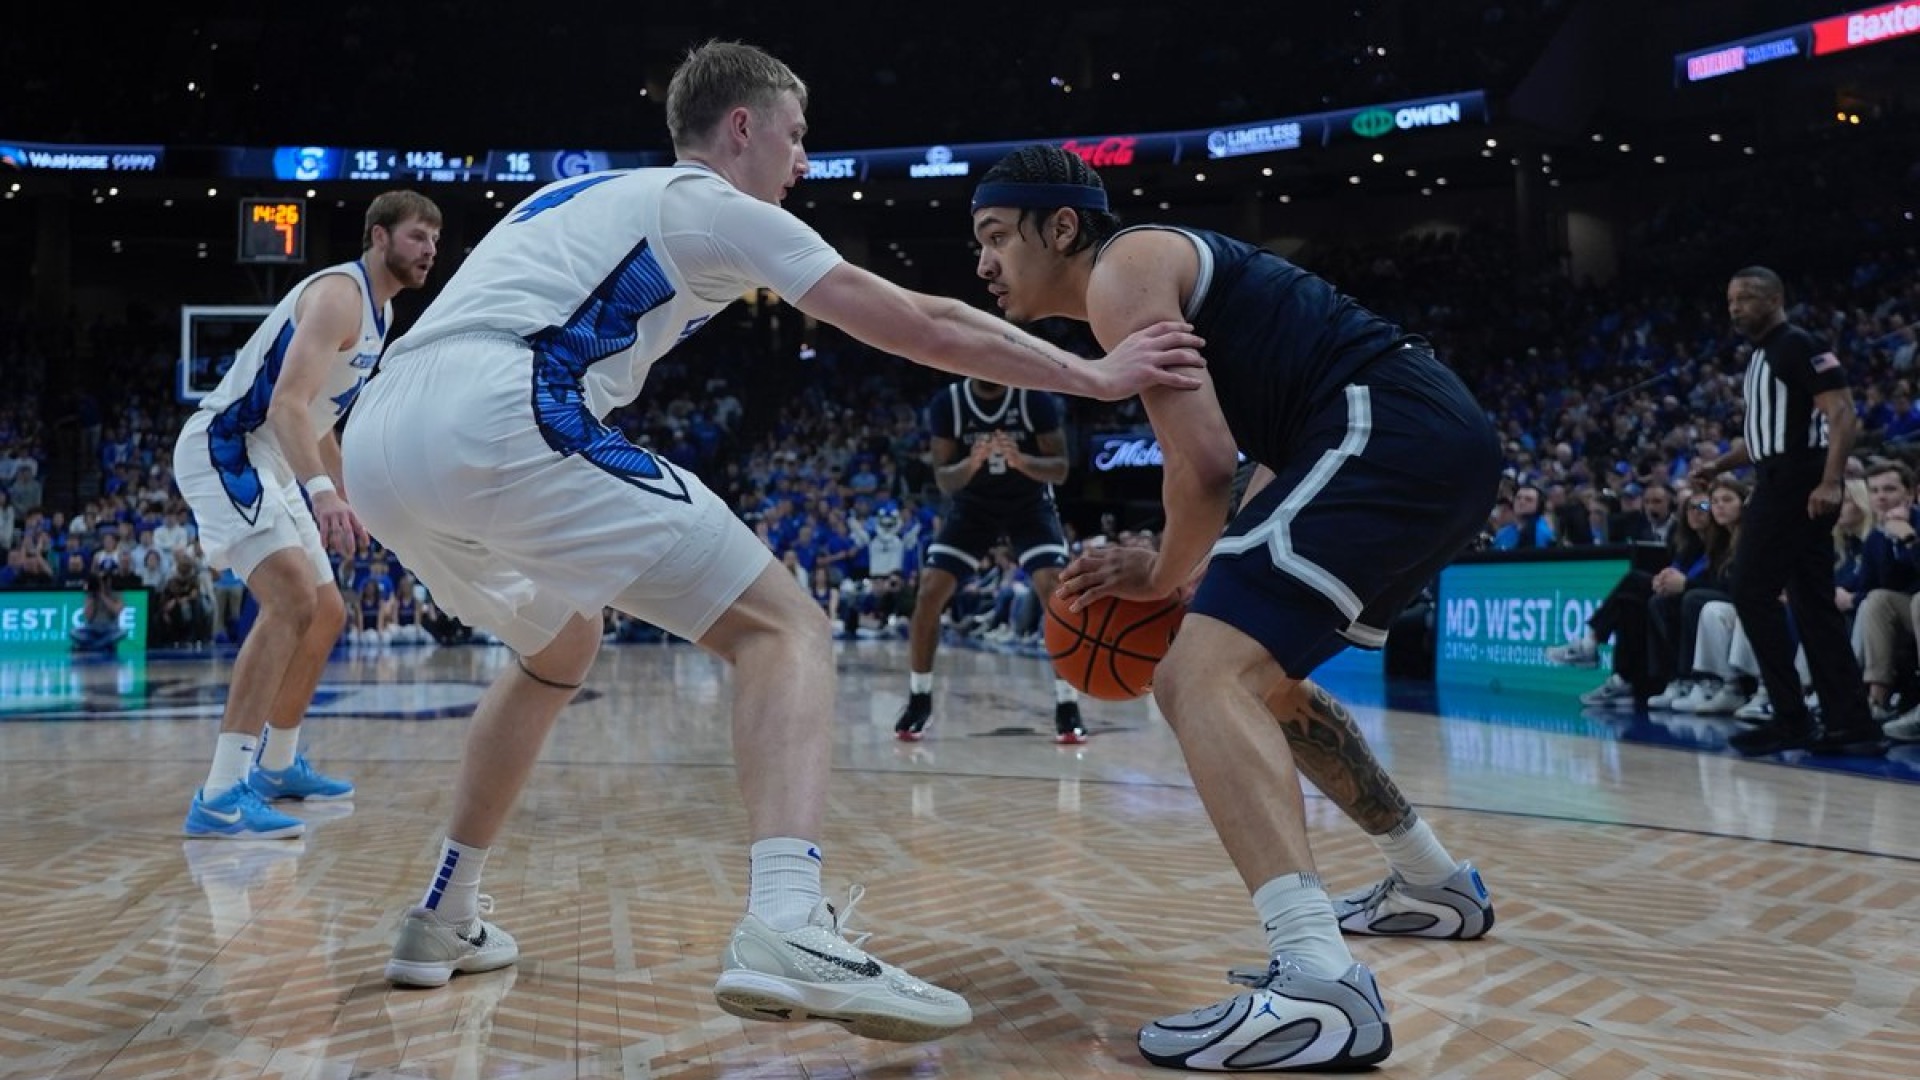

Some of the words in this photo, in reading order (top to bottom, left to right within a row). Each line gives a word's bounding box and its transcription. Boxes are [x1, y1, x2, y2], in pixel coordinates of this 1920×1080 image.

[1848, 5, 1920, 44] Baxte
[1395, 102, 1460, 129] OWEN
[355, 150, 379, 171] 15
[506, 152, 531, 173] 16
[253, 204, 299, 224] 14:26
[274, 223, 293, 255] 7
[1, 607, 58, 630] EST
[1445, 598, 1480, 639] MD
[1485, 598, 1553, 642] WEST
